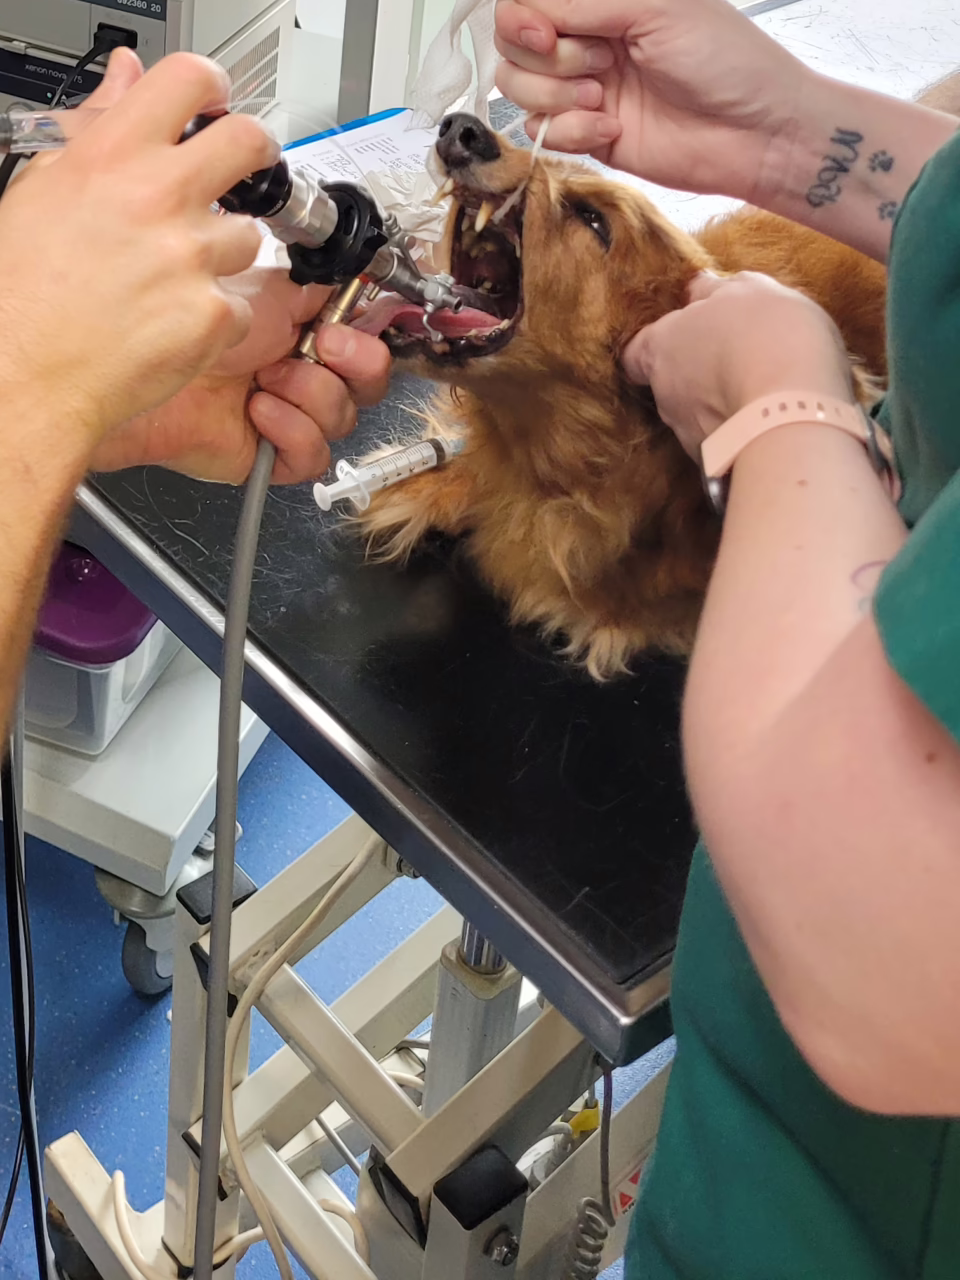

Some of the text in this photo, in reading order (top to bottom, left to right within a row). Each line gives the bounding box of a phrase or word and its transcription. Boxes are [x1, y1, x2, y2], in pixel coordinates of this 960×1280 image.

[150, 3, 162, 13] 20
[24, 63, 47, 76] xenon
[47, 68, 68, 80] nova
